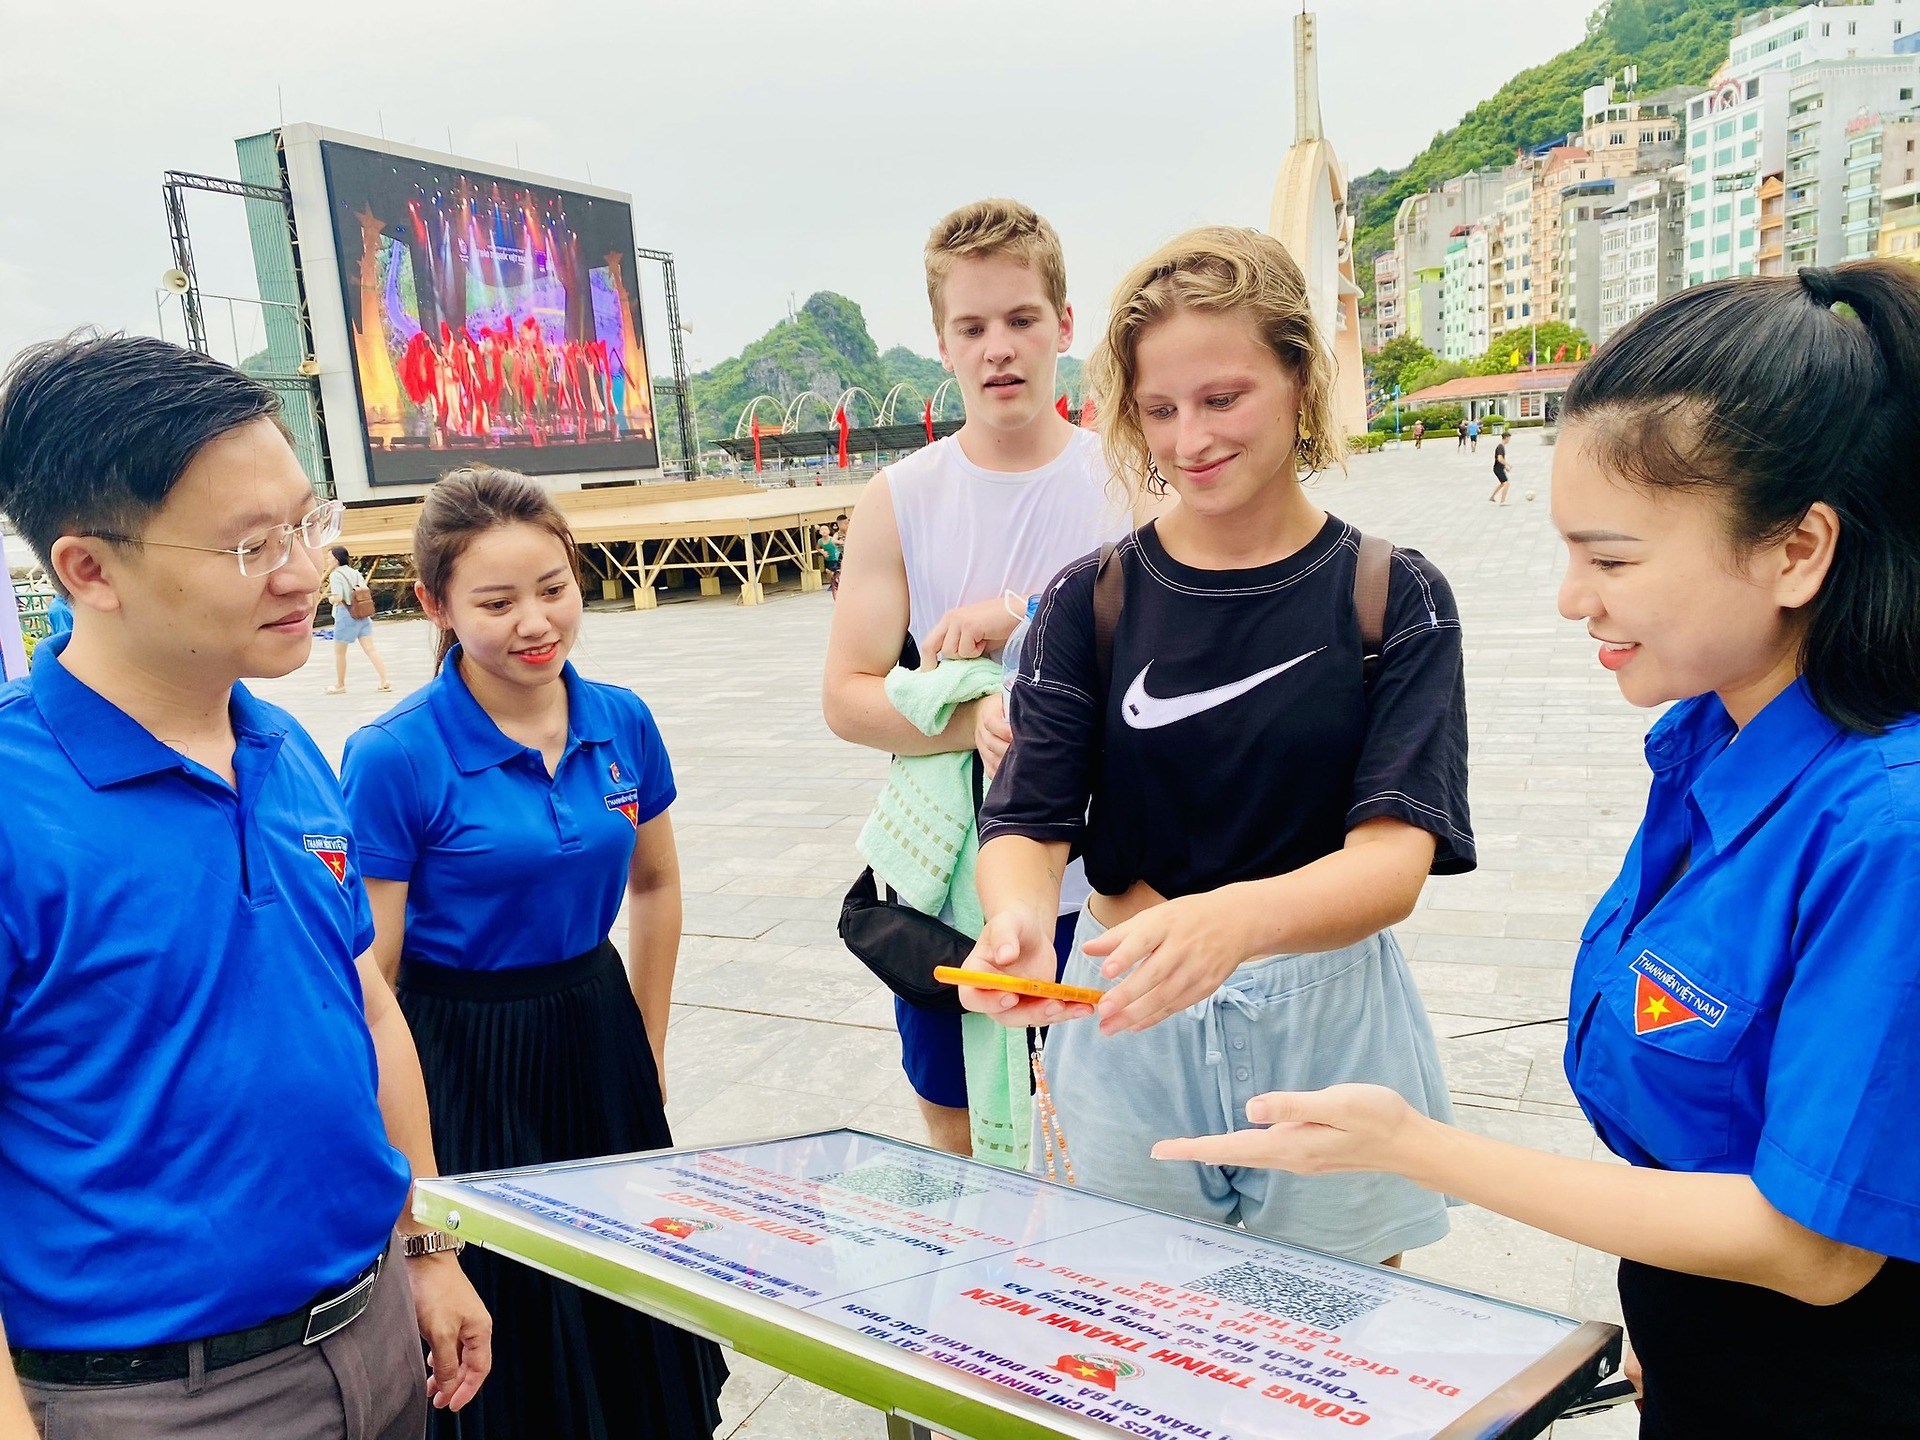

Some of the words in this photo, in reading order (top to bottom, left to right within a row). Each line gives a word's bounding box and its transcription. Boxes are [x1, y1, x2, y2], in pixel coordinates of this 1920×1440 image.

[1638, 955, 1664, 980] THANH
[1661, 973, 1678, 991] NIÊN
[1675, 986, 1695, 1003] VIỆT
[1693, 997, 1721, 1020] NAM
[737, 1175, 804, 1196] President
[694, 1187, 814, 1225] transformation
[742, 1190, 789, 1204] relics
[657, 1192, 759, 1222] PROJECT
[595, 1229, 635, 1243] YOUTH
[747, 1220, 825, 1245] YOUTH
[891, 1220, 940, 1234] place
[868, 1227, 954, 1256] historical
[936, 1233, 967, 1244] The
[983, 1236, 1014, 1246] Cat
[630, 1242, 706, 1269] COMMUNIST
[700, 1267, 740, 1282] MINH
[1047, 1267, 1109, 1288] Làng
[735, 1280, 763, 1290] CHI
[759, 1289, 784, 1298] HO
[1003, 1283, 1033, 1295] bá
[1140, 1281, 1175, 1295] Bà
[960, 1288, 1042, 1316] NIÊN
[1034, 1292, 1105, 1317] quảng
[1112, 1286, 1178, 1309] thăm
[1176, 1293, 1220, 1308] Cát
[841, 1304, 891, 1322] ĐVSN
[1115, 1304, 1156, 1319] văn
[1178, 1308, 1213, 1320] về
[1239, 1311, 1291, 1329] Hải
[888, 1321, 928, 1335] CÁC
[1037, 1313, 1148, 1353] THANH
[1108, 1315, 1172, 1340] trong
[1176, 1323, 1209, 1334] sử
[1216, 1320, 1259, 1334] Hồ
[1295, 1327, 1341, 1344] Cát
[925, 1334, 974, 1352] KHỐI
[1171, 1338, 1209, 1349] số
[1212, 1334, 1260, 1352] lịch
[1262, 1332, 1317, 1352] Bác
[971, 1350, 1027, 1372] ĐOÀN
[1264, 1350, 1314, 1369] tích
[1323, 1349, 1399, 1375] điểm
[1025, 1370, 1063, 1384] CHI
[1148, 1349, 1256, 1389] TRÌNH
[1316, 1367, 1347, 1377] di
[990, 1373, 1048, 1396] MINH
[1408, 1375, 1461, 1397] Địa
[1077, 1387, 1109, 1401] BÀ
[1261, 1384, 1371, 1426] CÔNG
